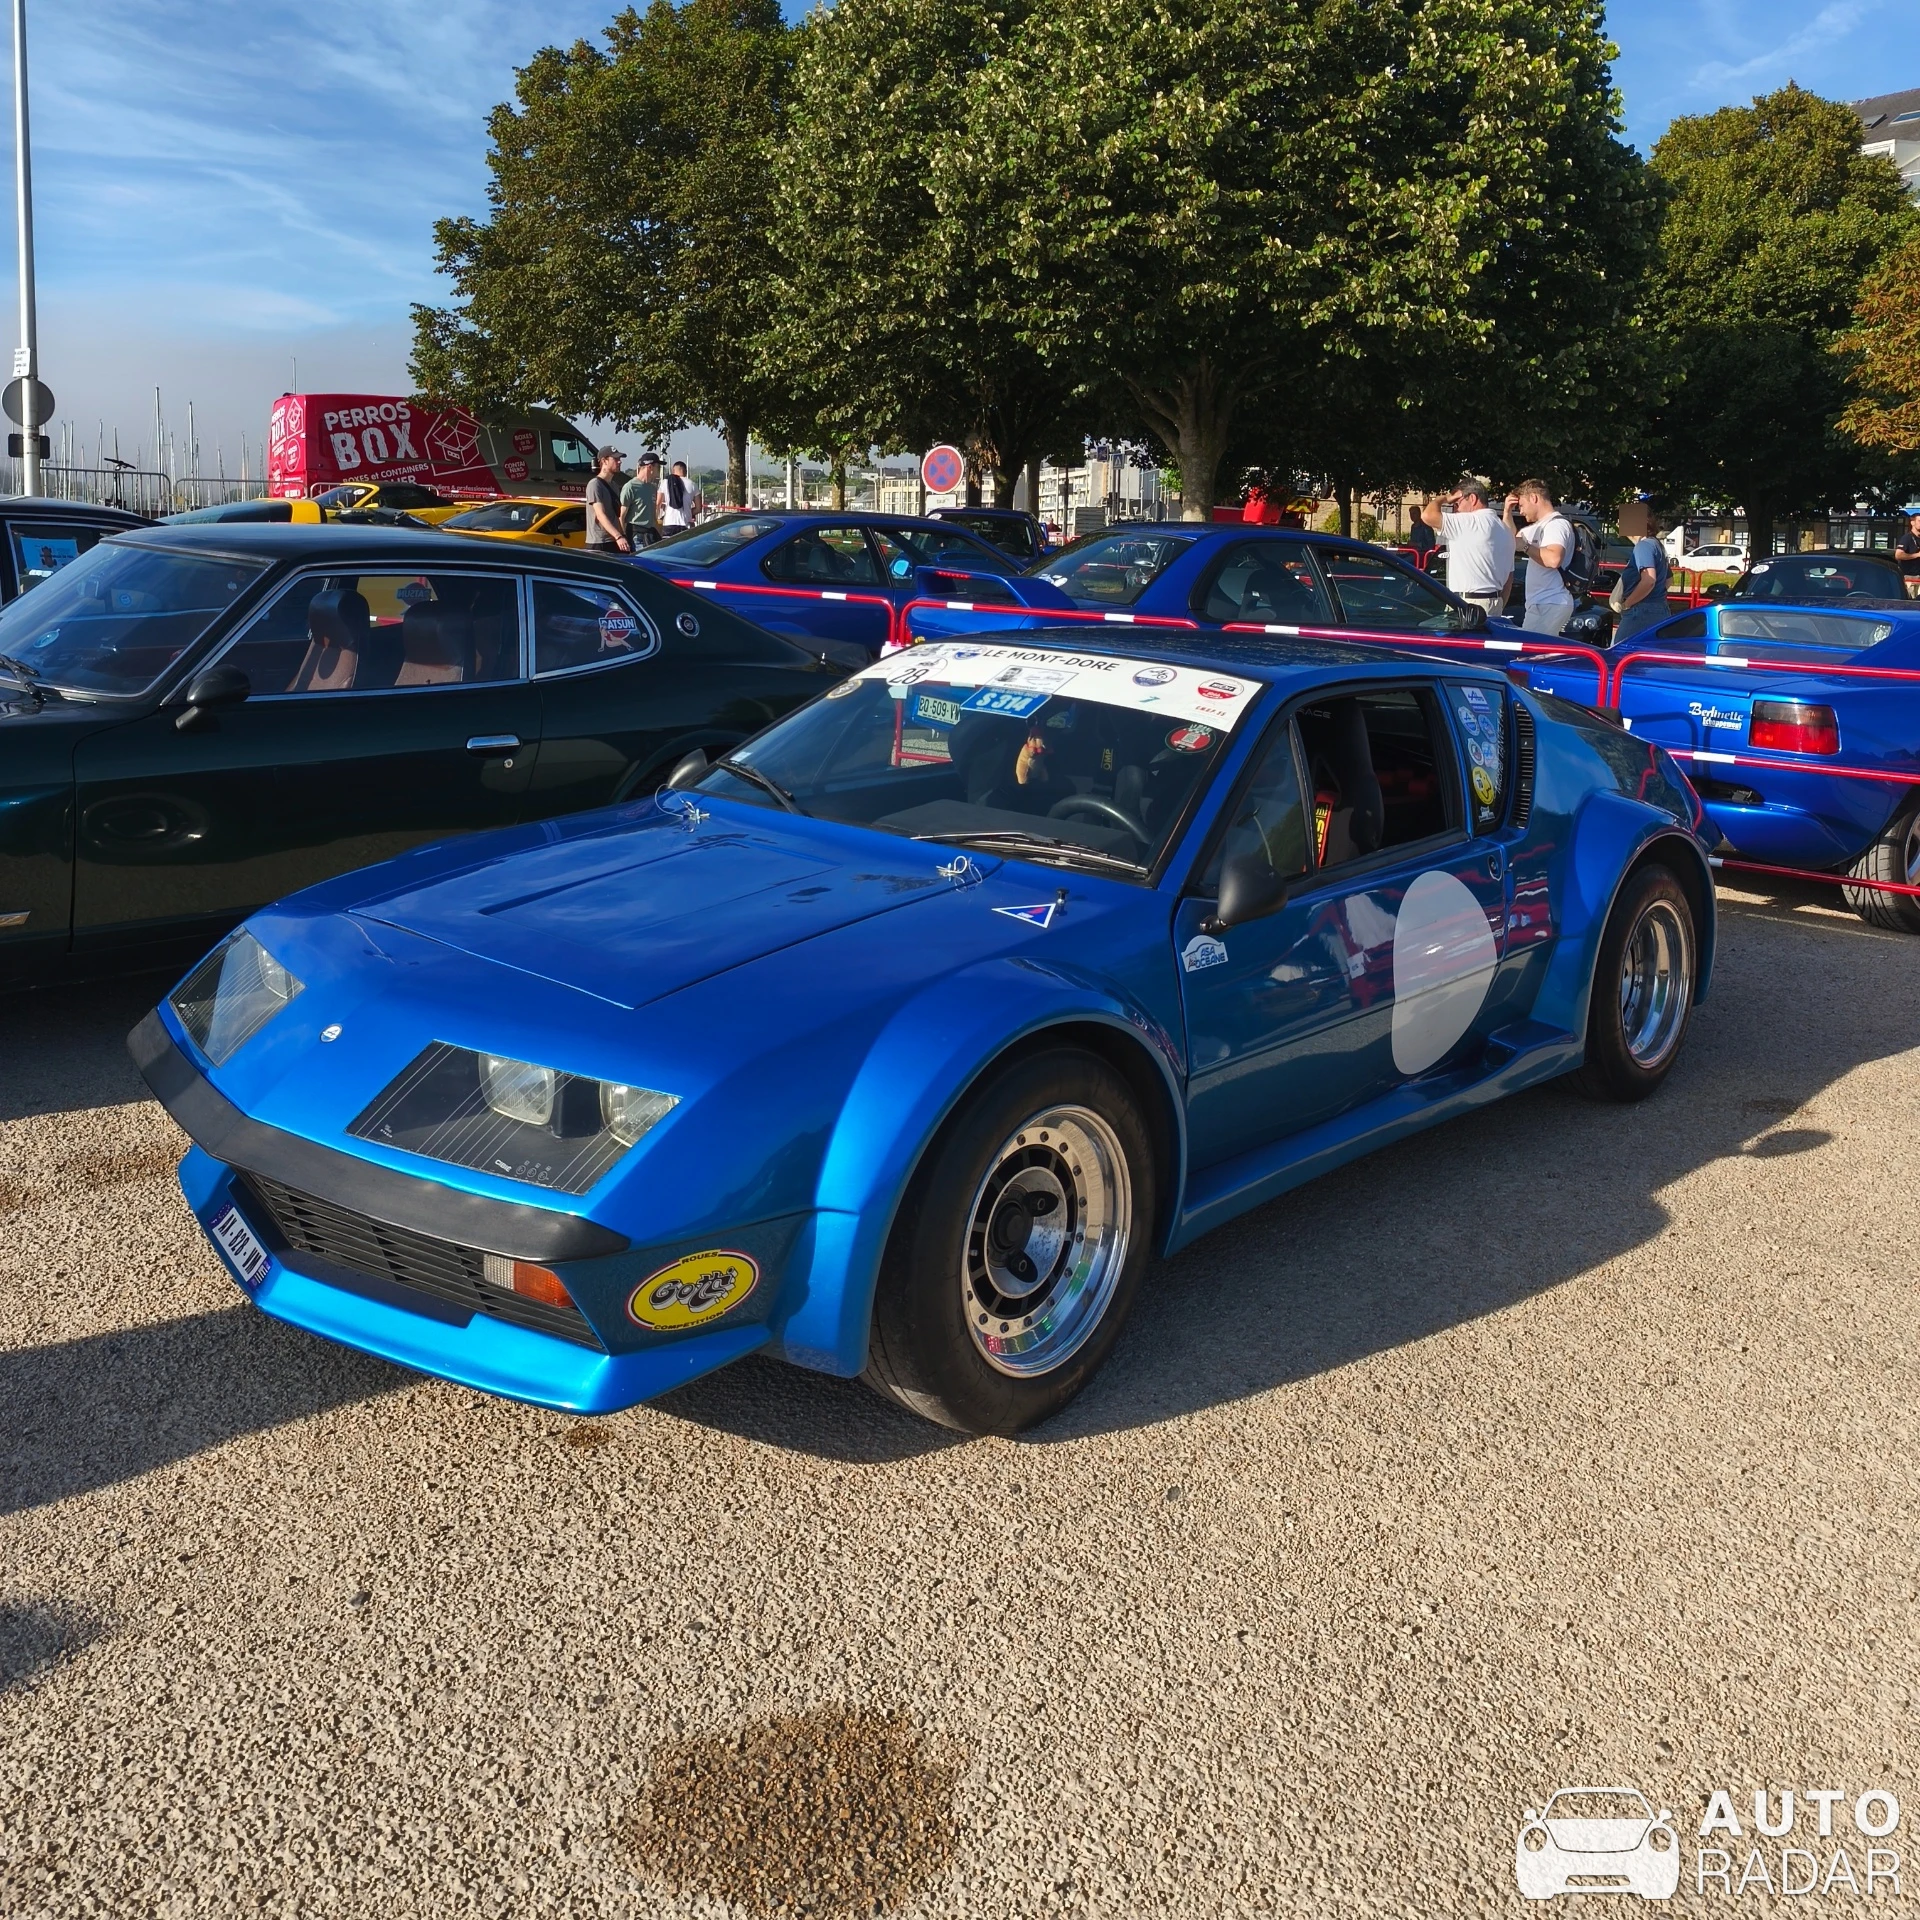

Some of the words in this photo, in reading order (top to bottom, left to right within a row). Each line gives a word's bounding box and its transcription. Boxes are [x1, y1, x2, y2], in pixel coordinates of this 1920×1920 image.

[324, 401, 411, 431] PERROS
[330, 422, 419, 470] BOX
[371, 472, 379, 480] et
[381, 463, 429, 479] CONTAINERS
[983, 649, 1005, 658] LE
[1006, 651, 1121, 672] MONT-DORE
[888, 667, 929, 685] 28
[976, 692, 998, 707] S
[991, 694, 1034, 711] 314
[1689, 702, 1744, 722] Berlinette
[1702, 717, 1742, 730] Echappement
[1103, 748, 1112, 770] OMP
[681, 1252, 719, 1264] ROUES
